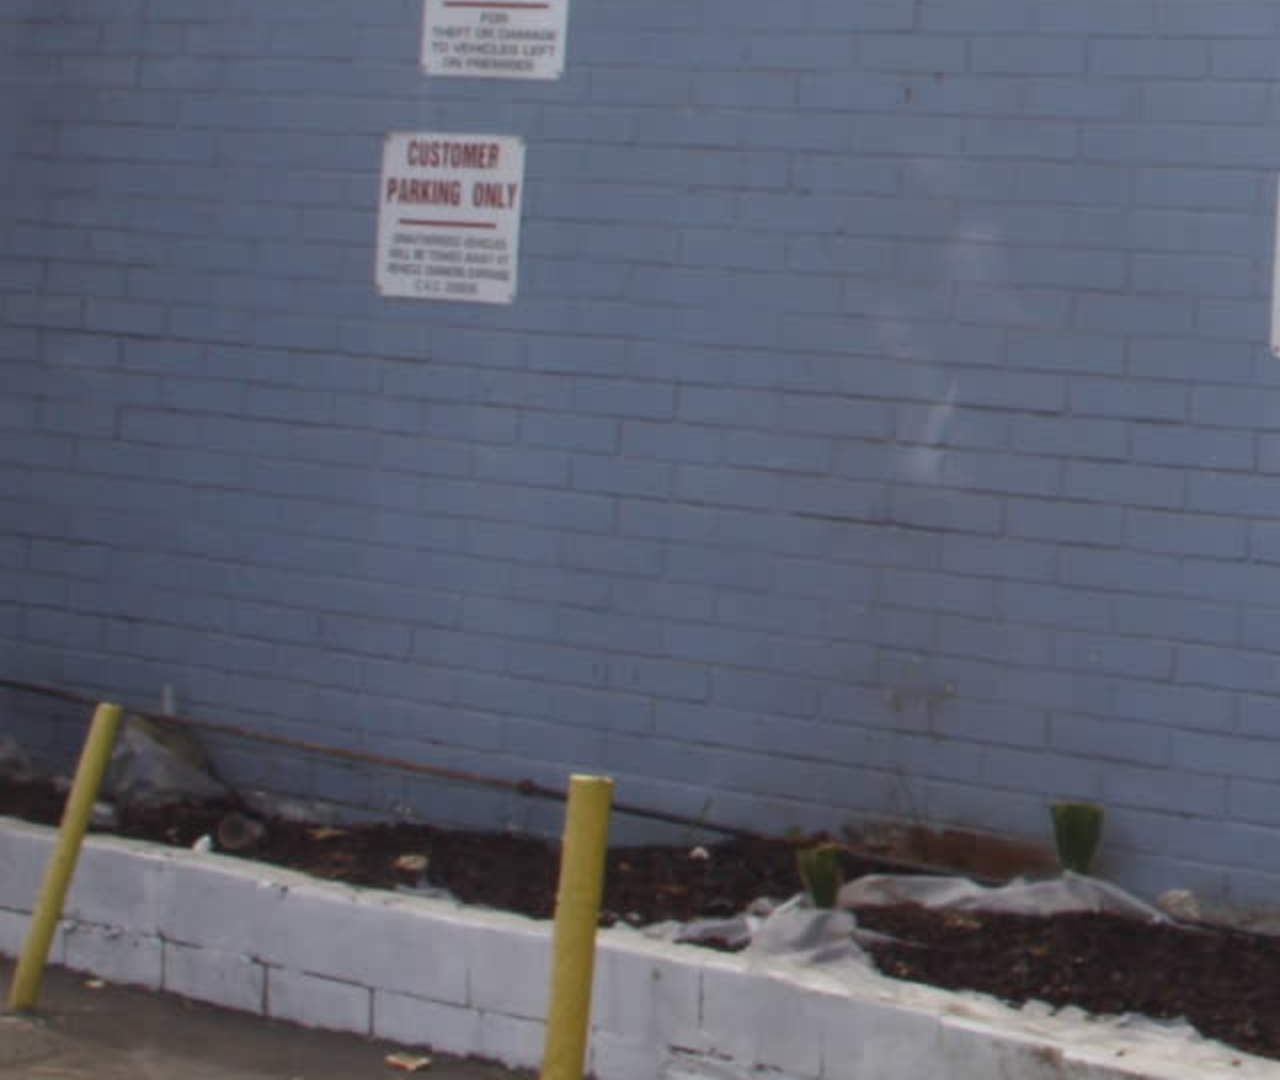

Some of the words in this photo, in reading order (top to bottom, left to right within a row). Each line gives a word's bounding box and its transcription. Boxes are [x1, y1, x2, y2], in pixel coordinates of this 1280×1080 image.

[407, 140, 500, 168] CUSTOMER
[387, 178, 462, 206] PARKING
[472, 182, 518, 209] ONLY
